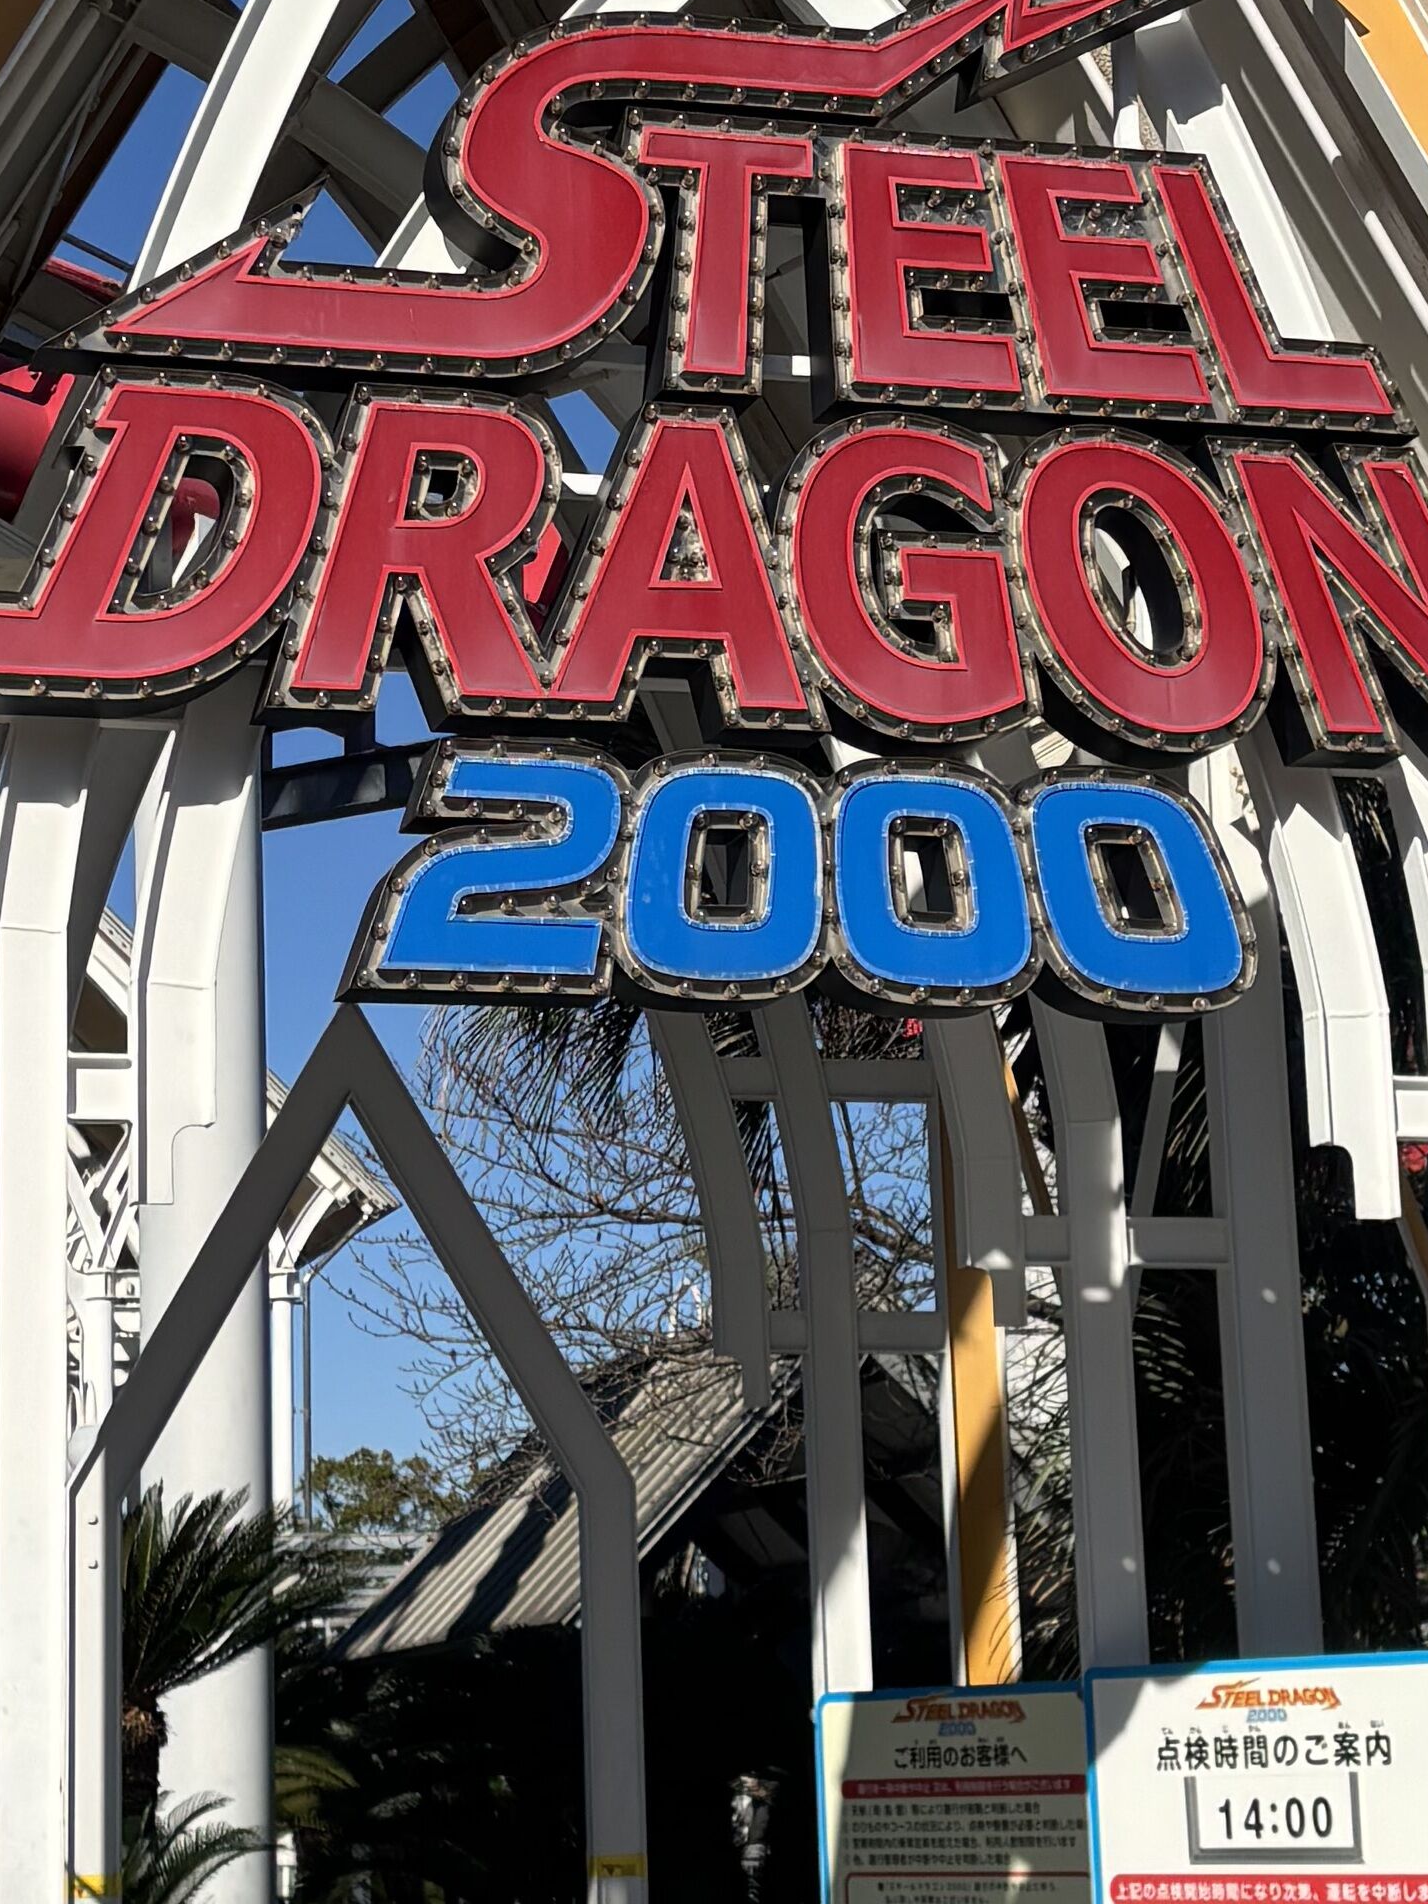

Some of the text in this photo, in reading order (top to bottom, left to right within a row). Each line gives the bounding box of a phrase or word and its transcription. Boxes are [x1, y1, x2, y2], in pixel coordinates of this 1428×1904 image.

[338, 737, 1258, 1014] 2000
[1196, 1677, 1341, 1710] STEEL DRAGON
[1246, 1708, 1288, 1723] 2000
[893, 1744, 1029, 1770] ご利用のお客様へ
[1156, 1730, 1392, 1771] 点検時間のご案内
[1218, 1796, 1333, 1840] 14:00
